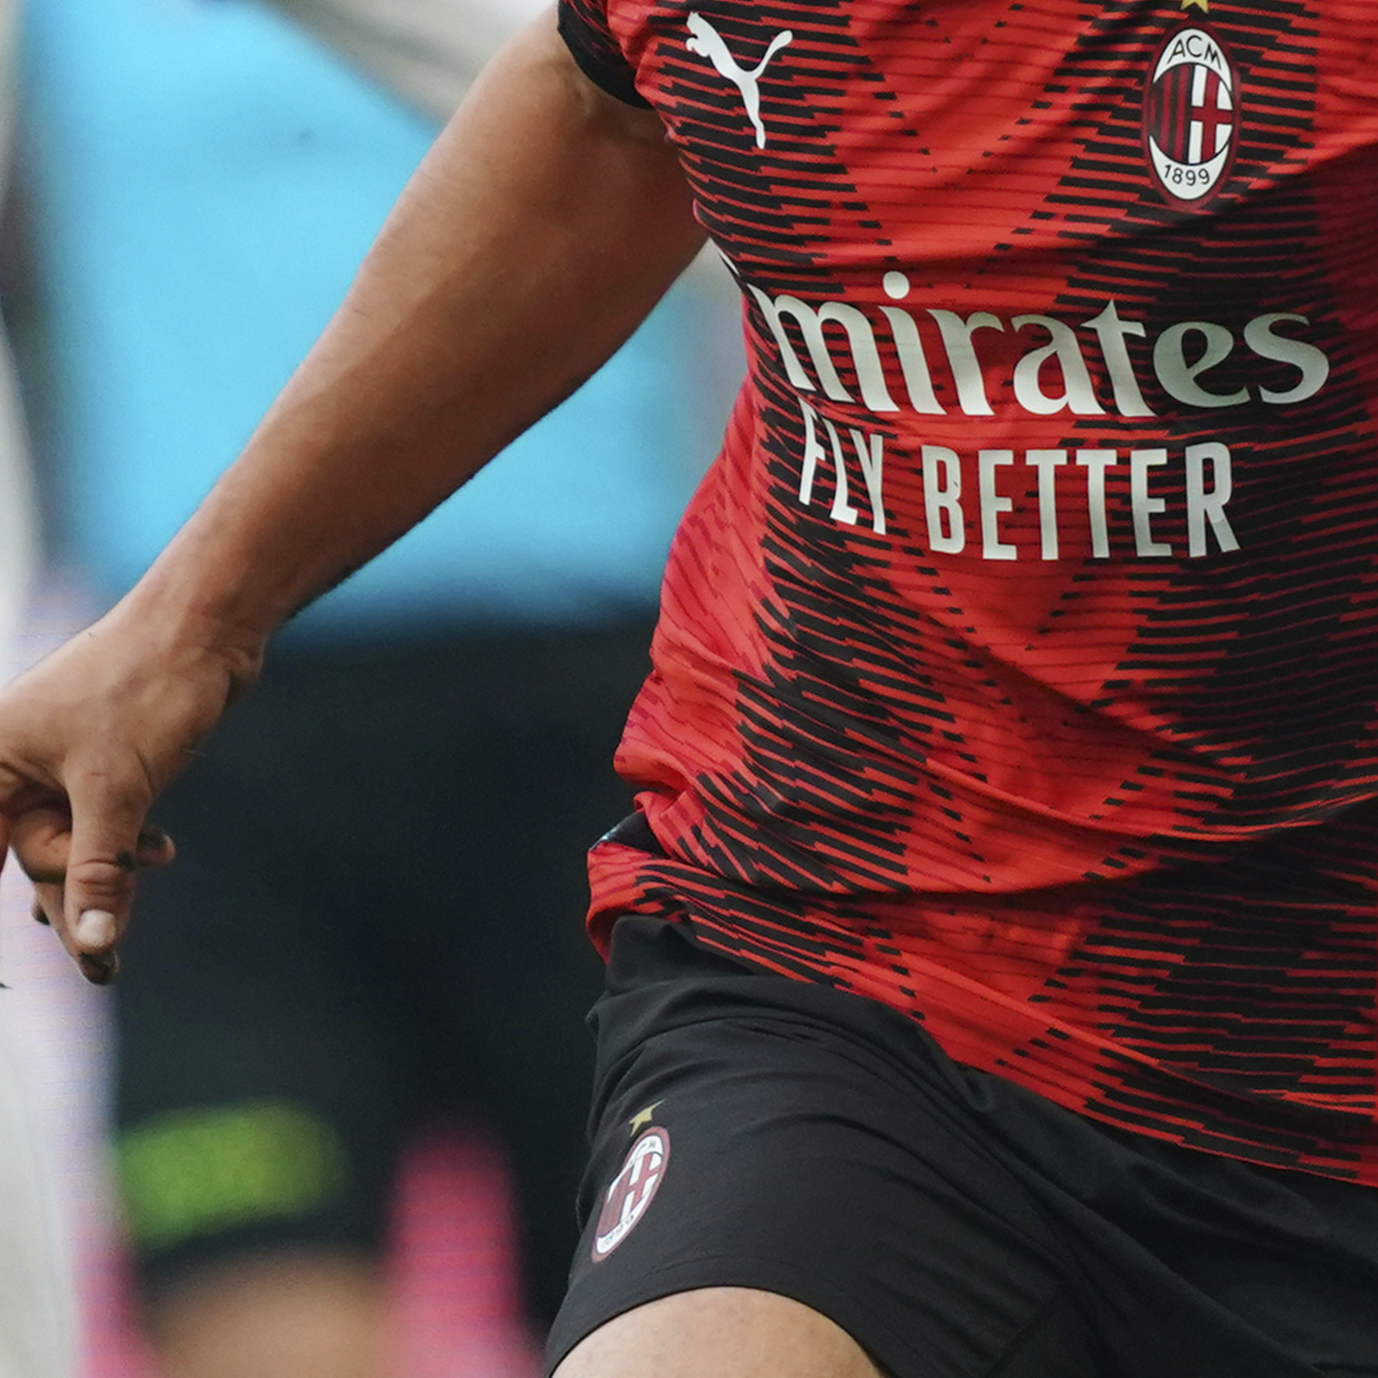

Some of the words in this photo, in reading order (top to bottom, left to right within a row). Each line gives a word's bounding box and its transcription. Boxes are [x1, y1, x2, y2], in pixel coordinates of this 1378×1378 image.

[1167, 35, 1222, 71] ACM
[1163, 164, 1210, 187] 1899
[716, 246, 1330, 417] mirates
[798, 396, 887, 535] FLY
[921, 441, 1241, 561] BETTER
